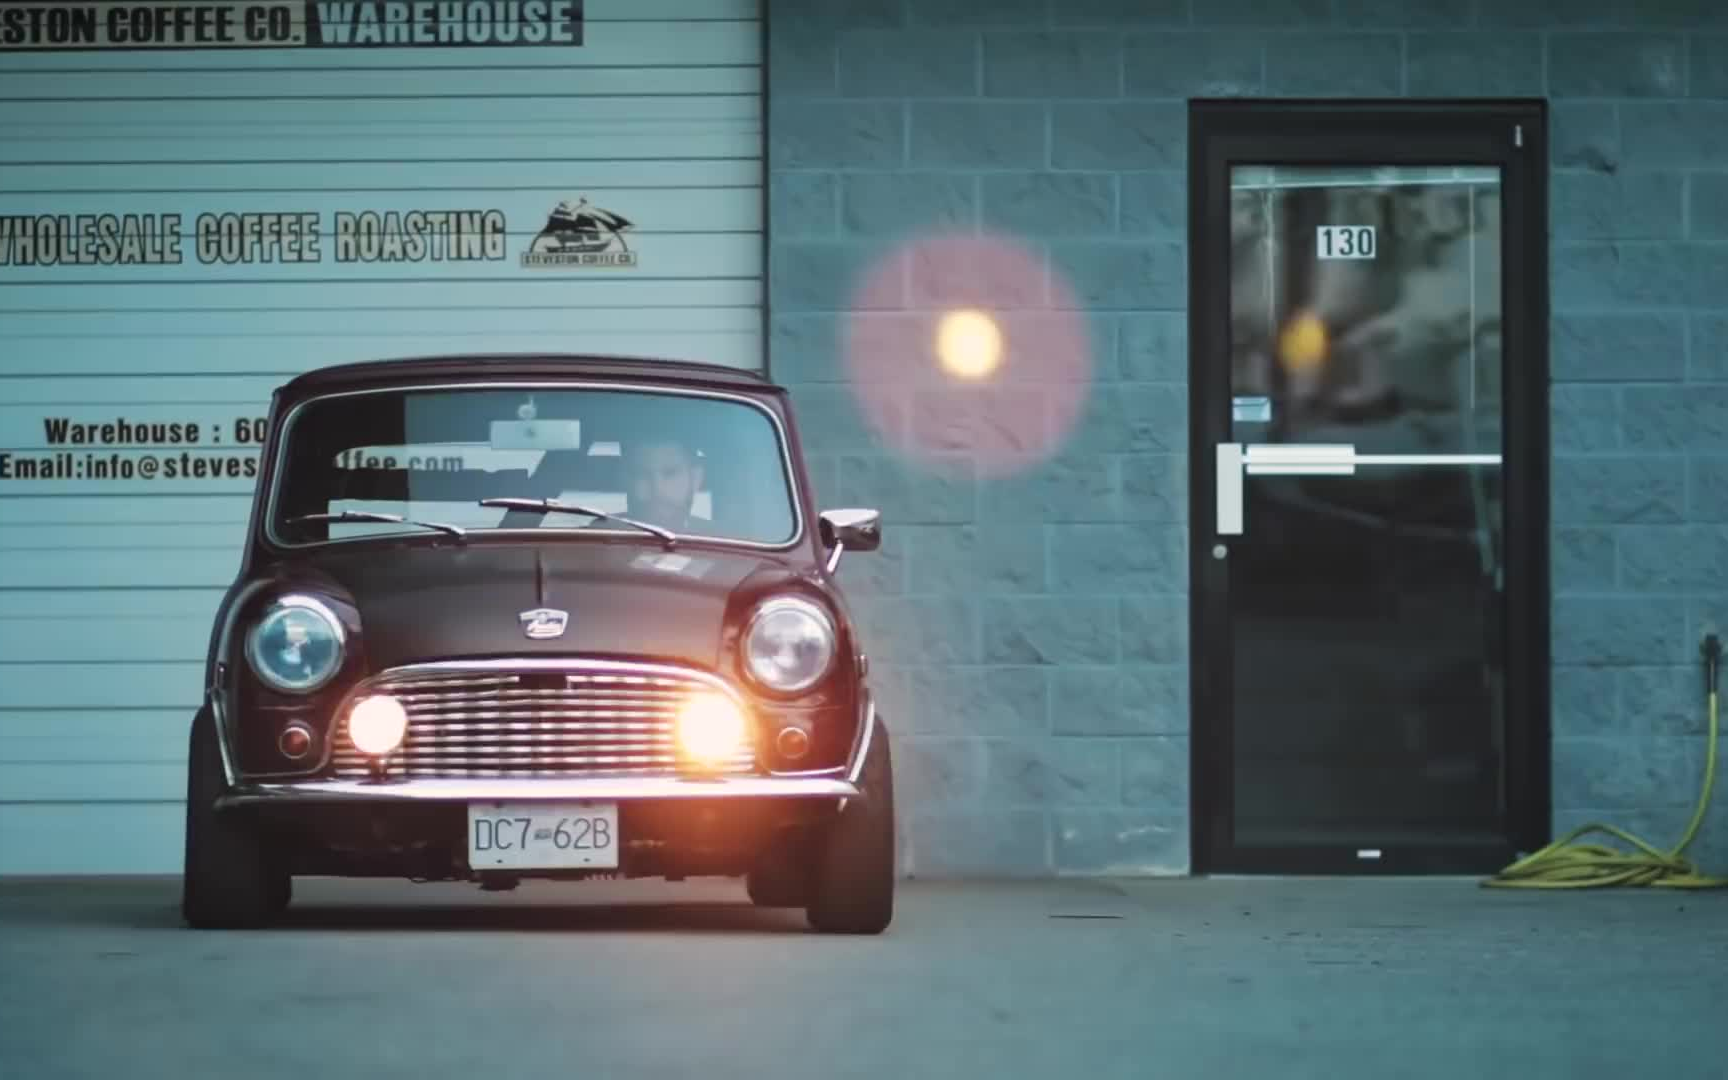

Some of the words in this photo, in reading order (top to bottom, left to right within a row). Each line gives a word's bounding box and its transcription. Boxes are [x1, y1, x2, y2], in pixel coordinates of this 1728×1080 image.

[0, 7, 96, 43] STON
[106, 6, 235, 42] COFFEE
[244, 6, 301, 41] CO.
[317, 2, 573, 42] WAREHOUSE
[196, 212, 321, 264] COFFEE
[334, 209, 506, 262] ROASTING
[1323, 228, 1372, 256] 130
[44, 417, 199, 444] Warehouse
